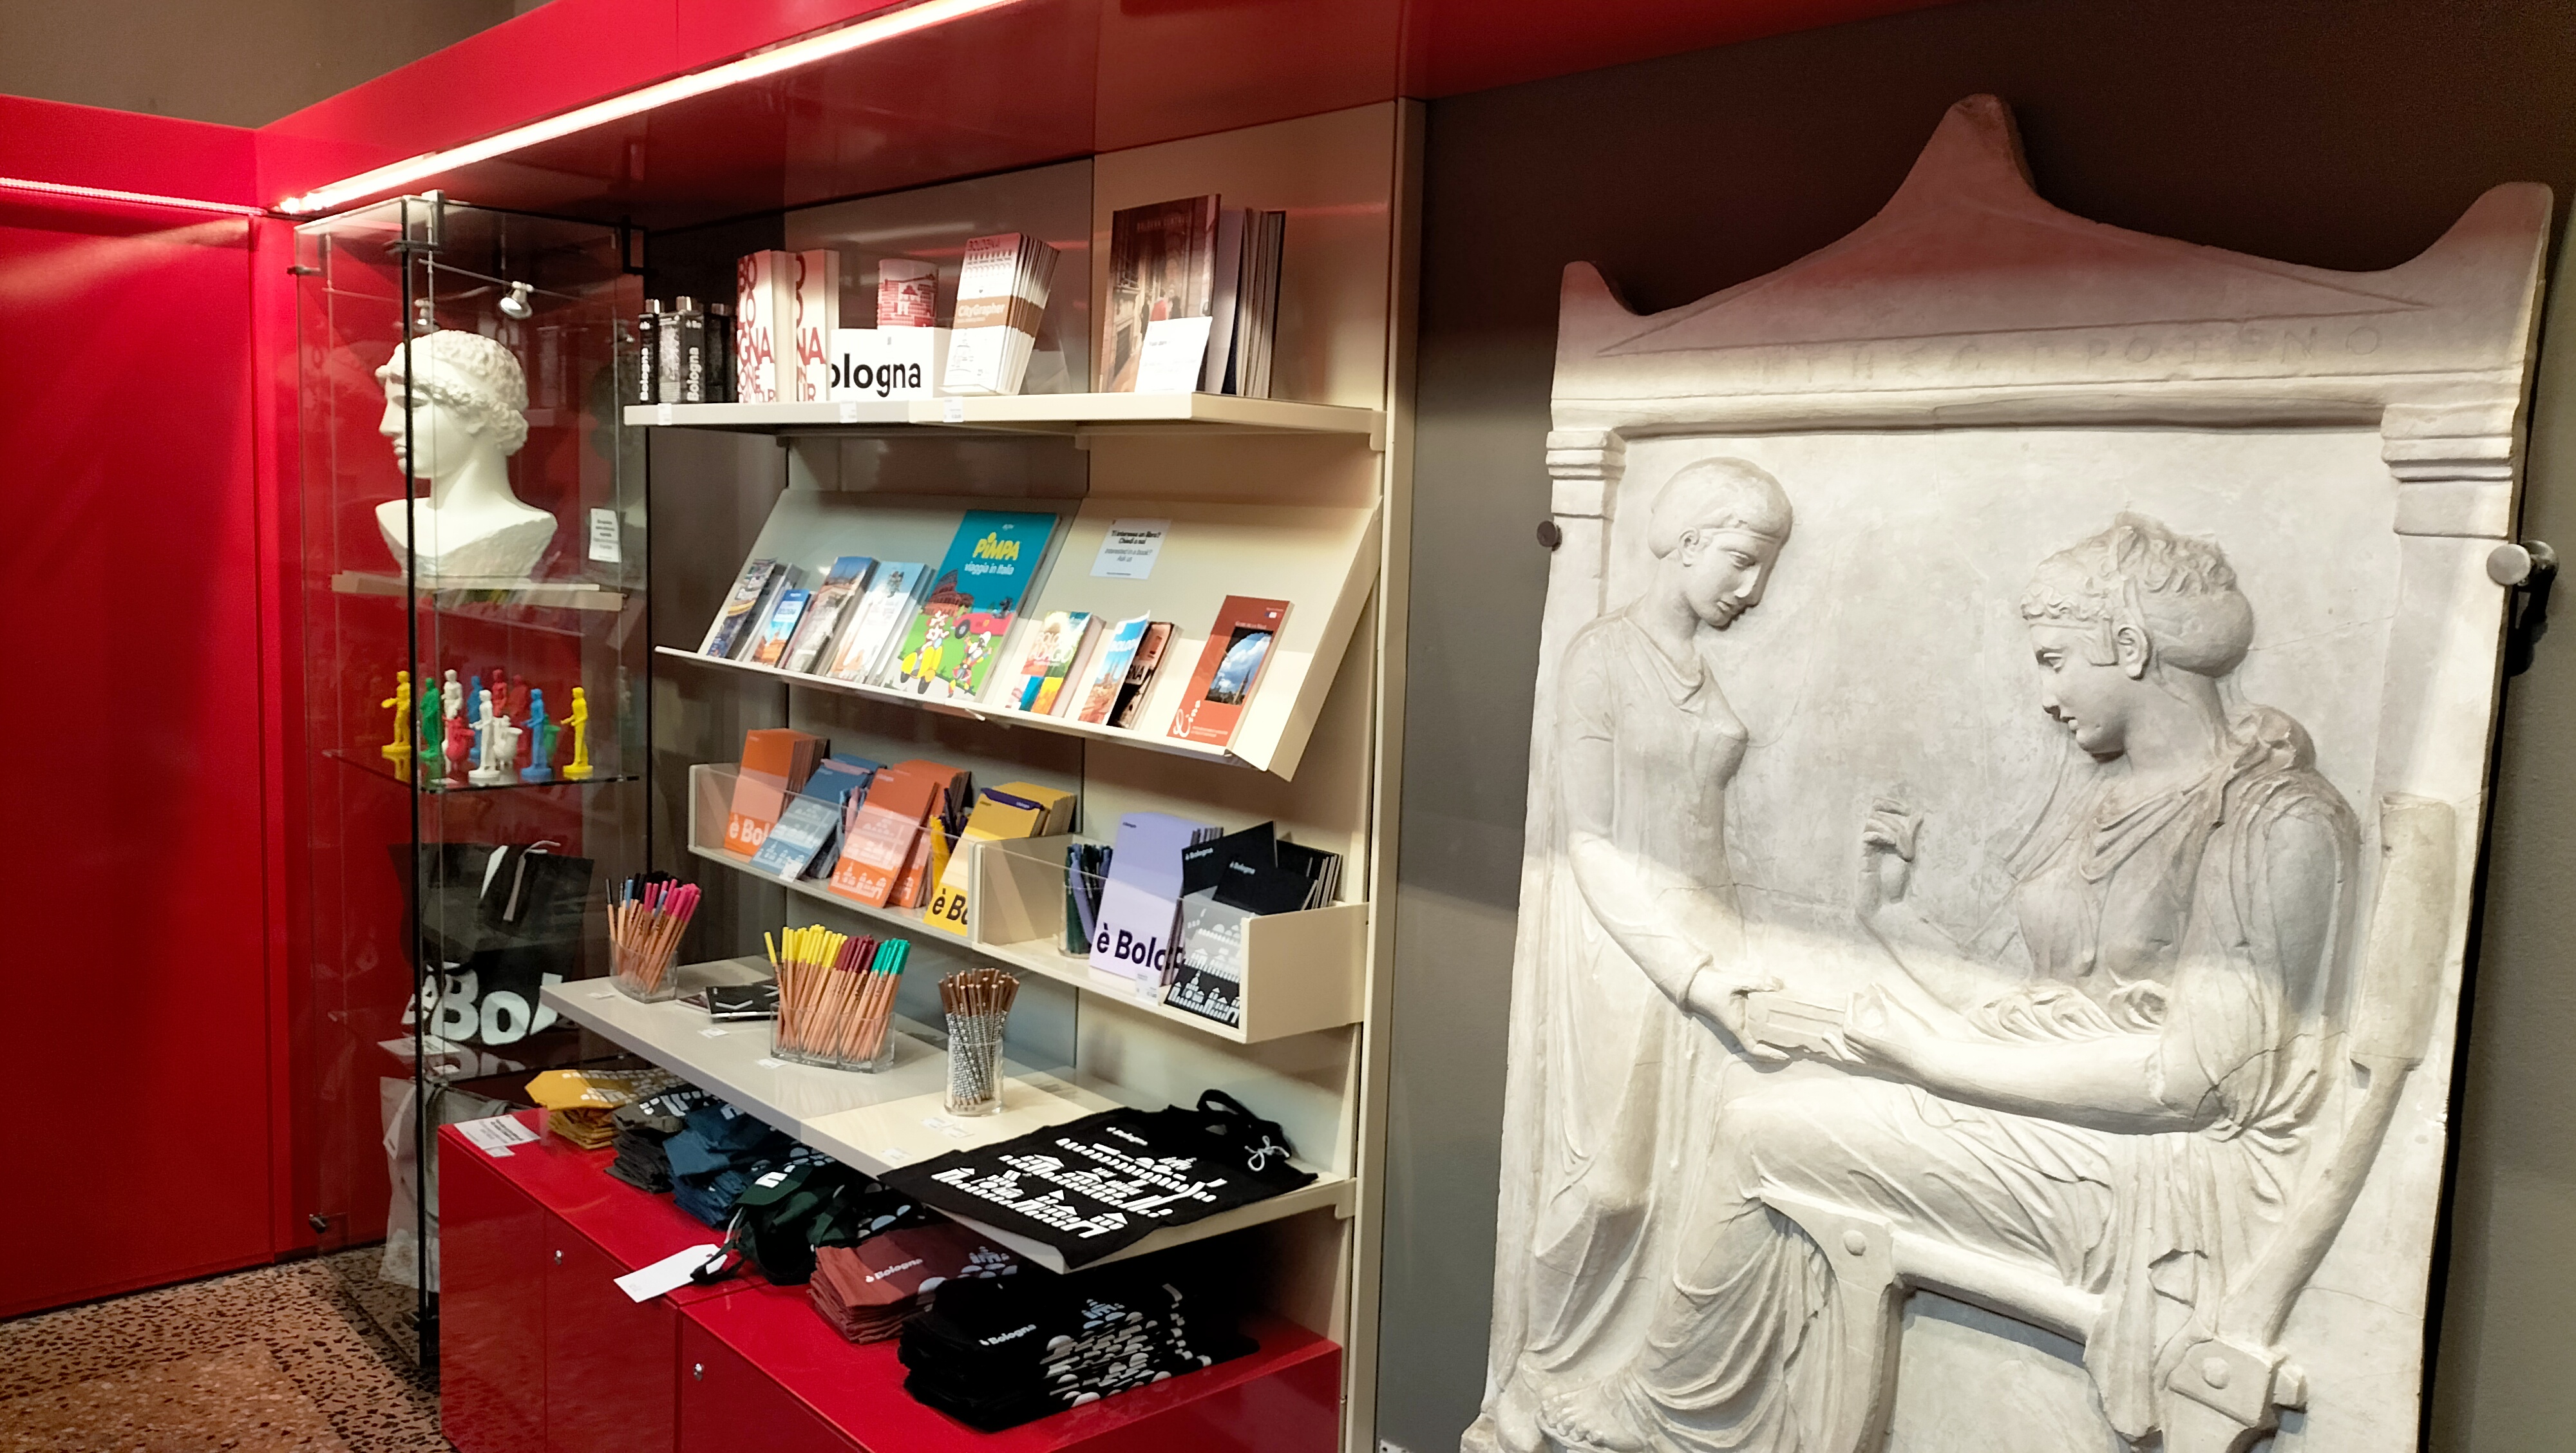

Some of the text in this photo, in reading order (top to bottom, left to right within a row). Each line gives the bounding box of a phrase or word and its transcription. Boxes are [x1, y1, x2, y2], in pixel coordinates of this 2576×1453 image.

[640, 348, 650, 401] Bologna
[687, 347, 702, 401] Bologna
[989, 562, 997, 573] in
[932, 888, 947, 915] è
[1097, 922, 1110, 954] è
[874, 1258, 923, 1280] Bologna
[987, 1324, 1037, 1345] Bologna
